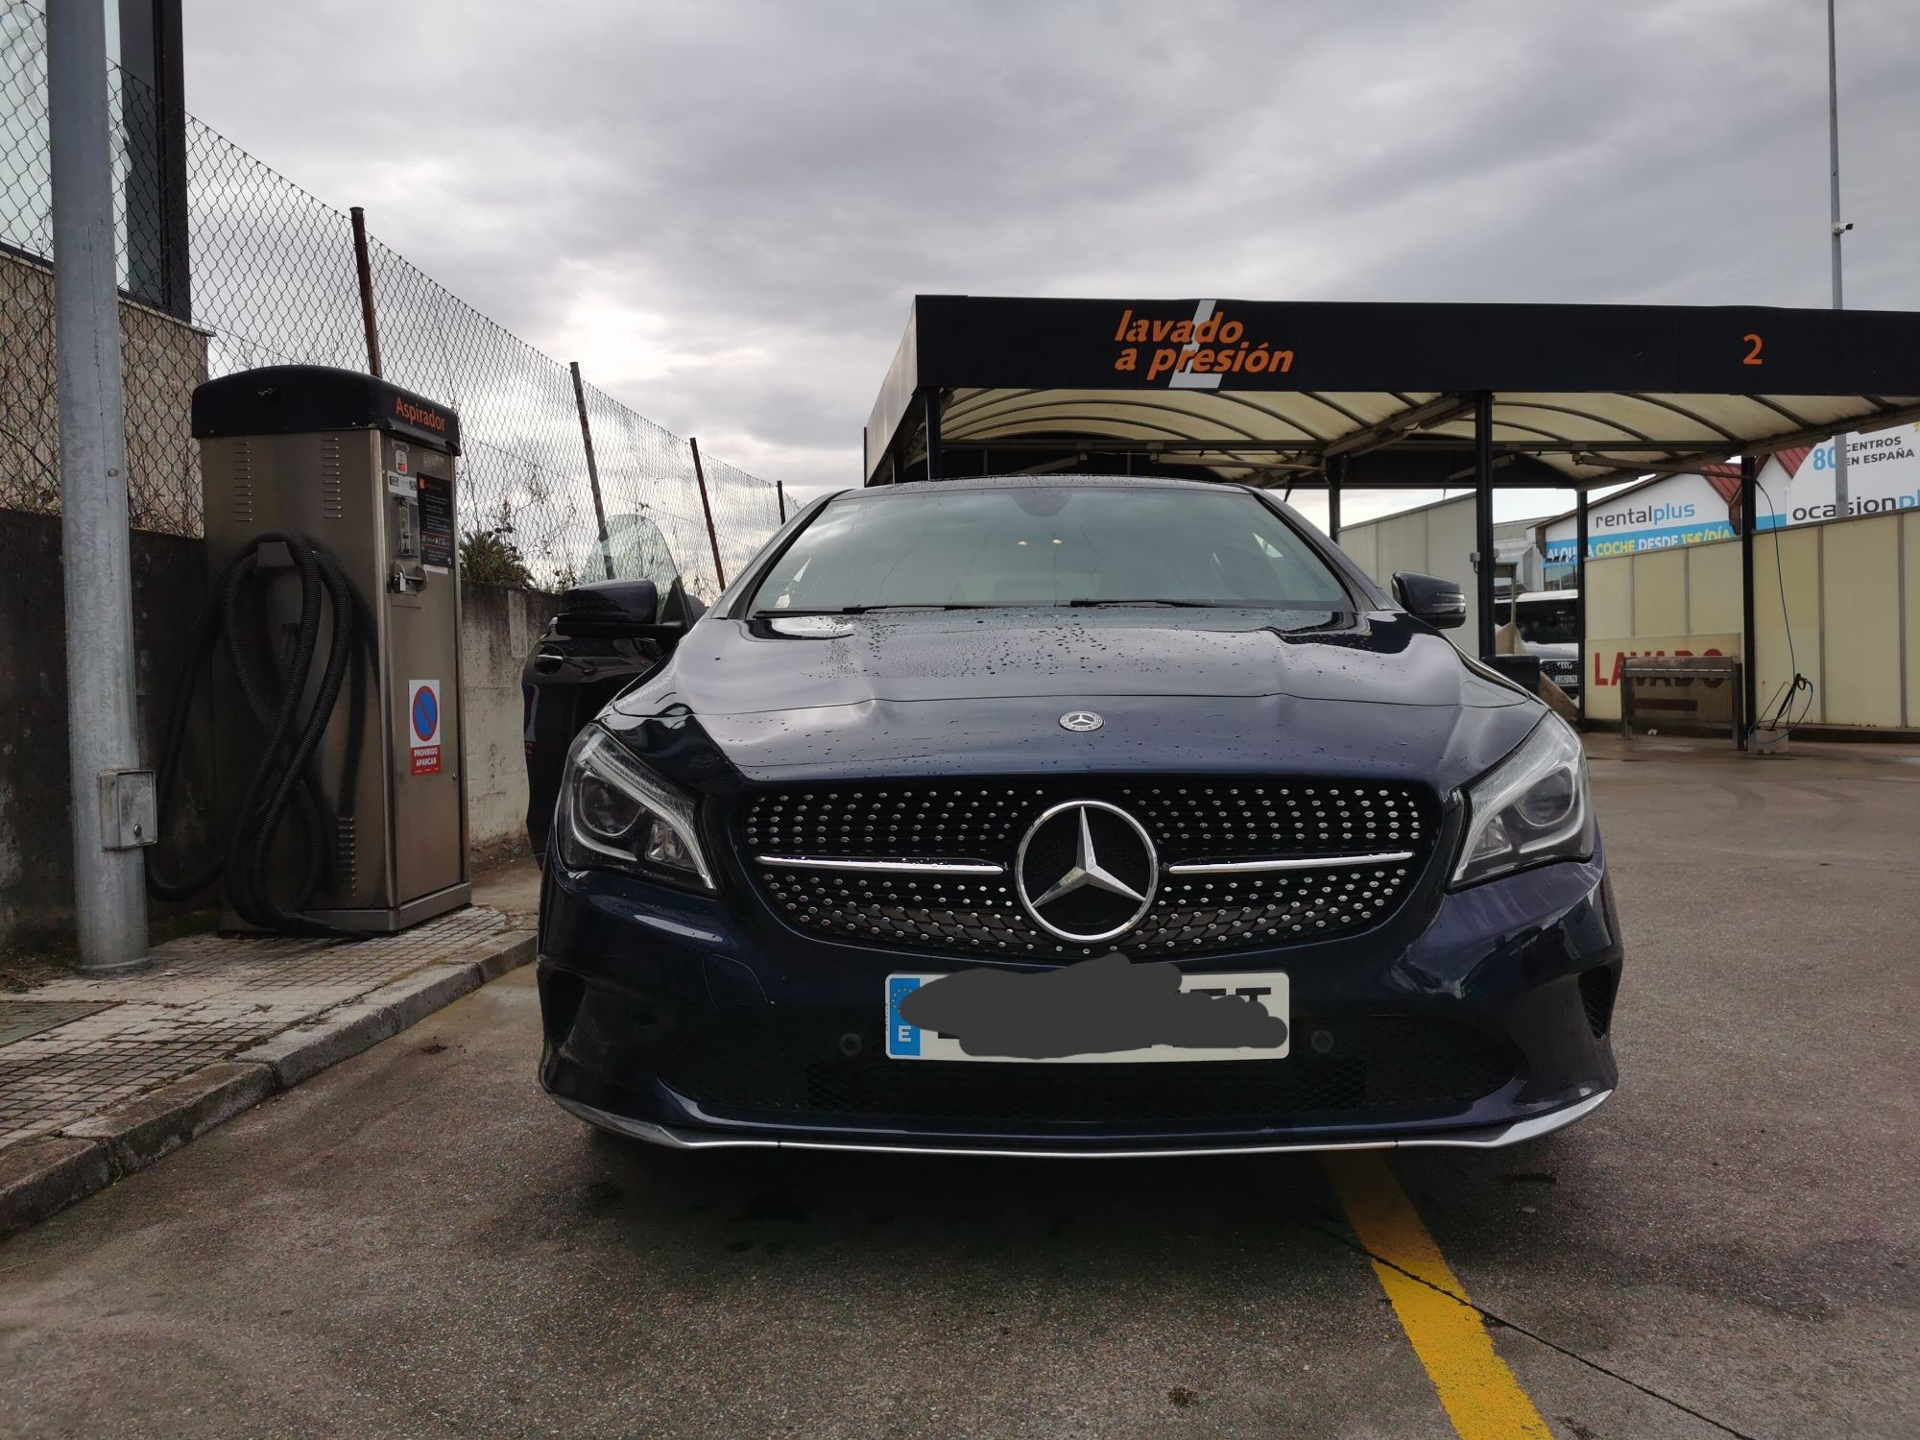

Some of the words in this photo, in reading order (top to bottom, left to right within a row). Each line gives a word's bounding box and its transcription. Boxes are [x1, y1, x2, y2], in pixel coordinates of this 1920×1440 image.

[1114, 310, 1244, 343] lavado
[1114, 347, 1138, 371] a
[1146, 342, 1295, 380] presión
[1743, 333, 1763, 365] 2
[395, 396, 446, 432] Aspirador
[1863, 447, 1915, 464] ESPAÑA
[1596, 503, 1696, 528] rentalplus
[1547, 544, 1595, 562] ALQUA
[1596, 540, 1636, 557] COCHE
[1639, 534, 1678, 551] DESDE
[898, 1025, 912, 1042] E
